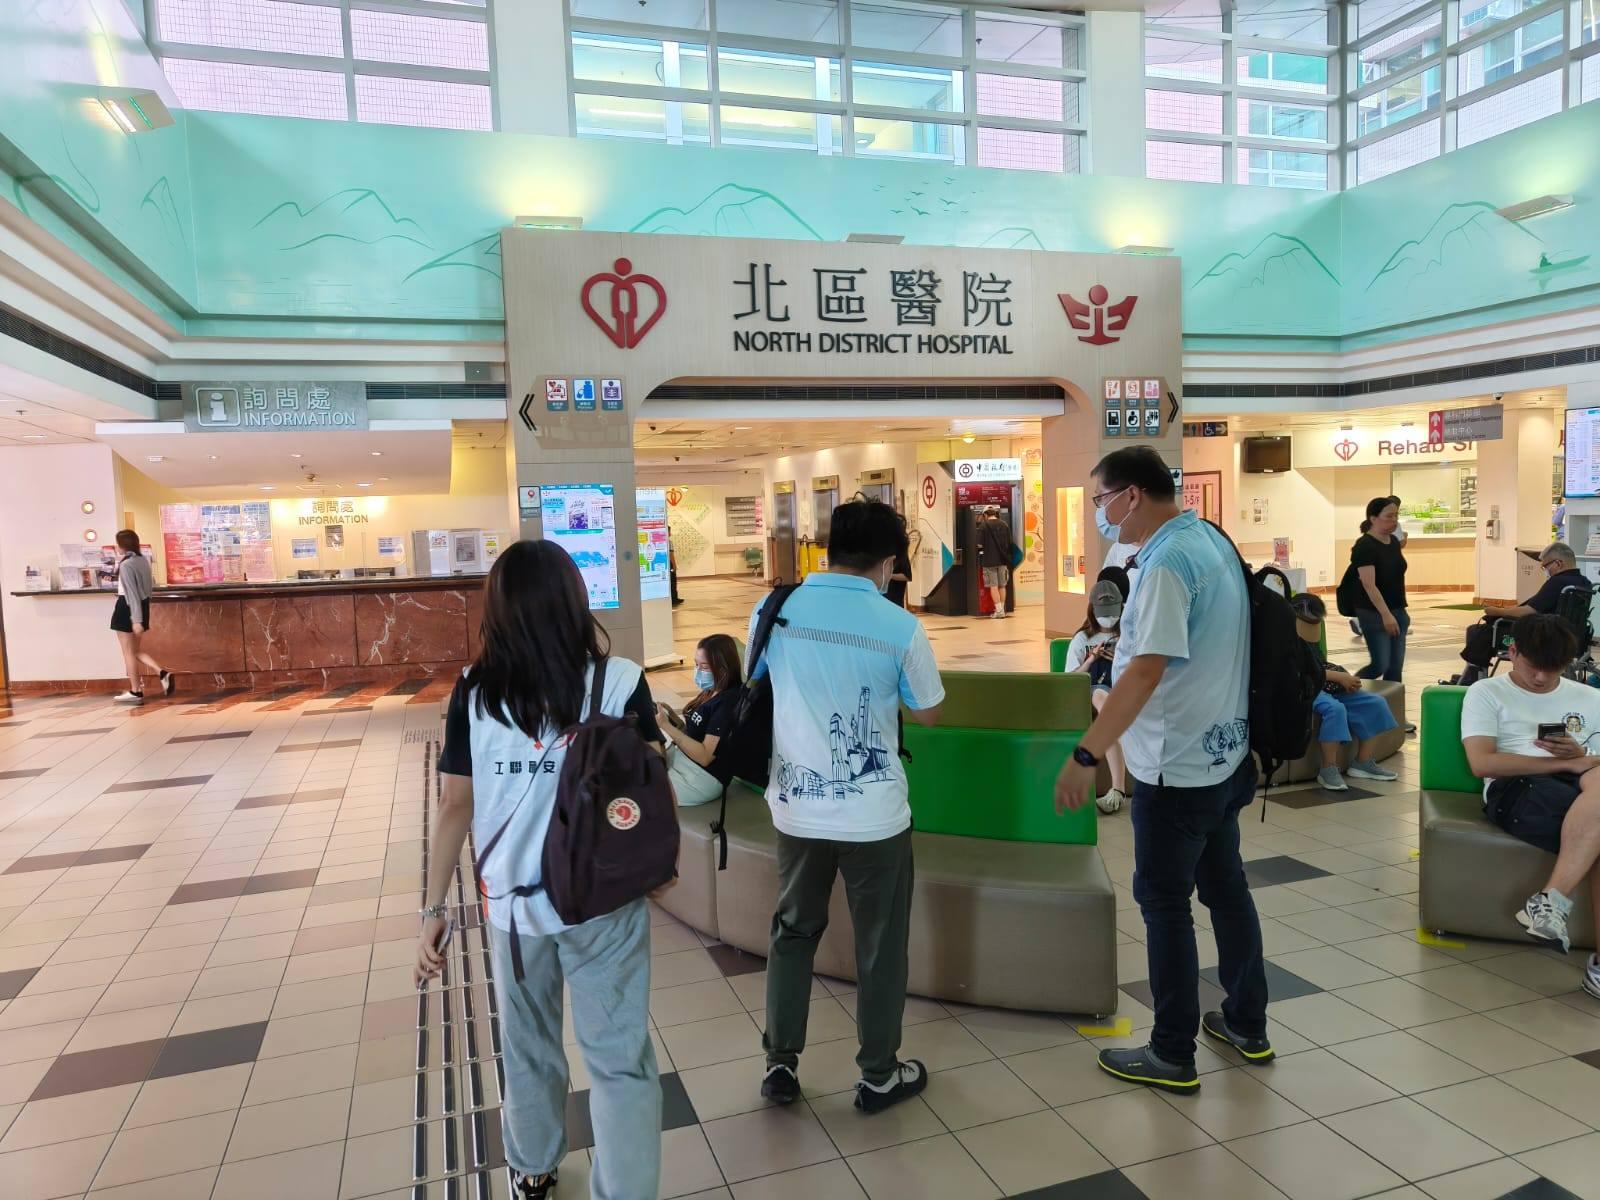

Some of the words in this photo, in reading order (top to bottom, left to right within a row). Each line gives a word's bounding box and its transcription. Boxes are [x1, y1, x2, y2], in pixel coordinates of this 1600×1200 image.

[733, 262, 1013, 327] 北區醫院
[733, 330, 812, 353] NORTH
[819, 332, 912, 354] DISTRICT
[918, 333, 1013, 355] HOSPITAL
[243, 387, 332, 410] 詢問處
[244, 411, 356, 427] INFORMATION
[1378, 439, 1445, 456] Rehab
[312, 501, 354, 514] 詢問處
[299, 514, 369, 526] INFORMATION
